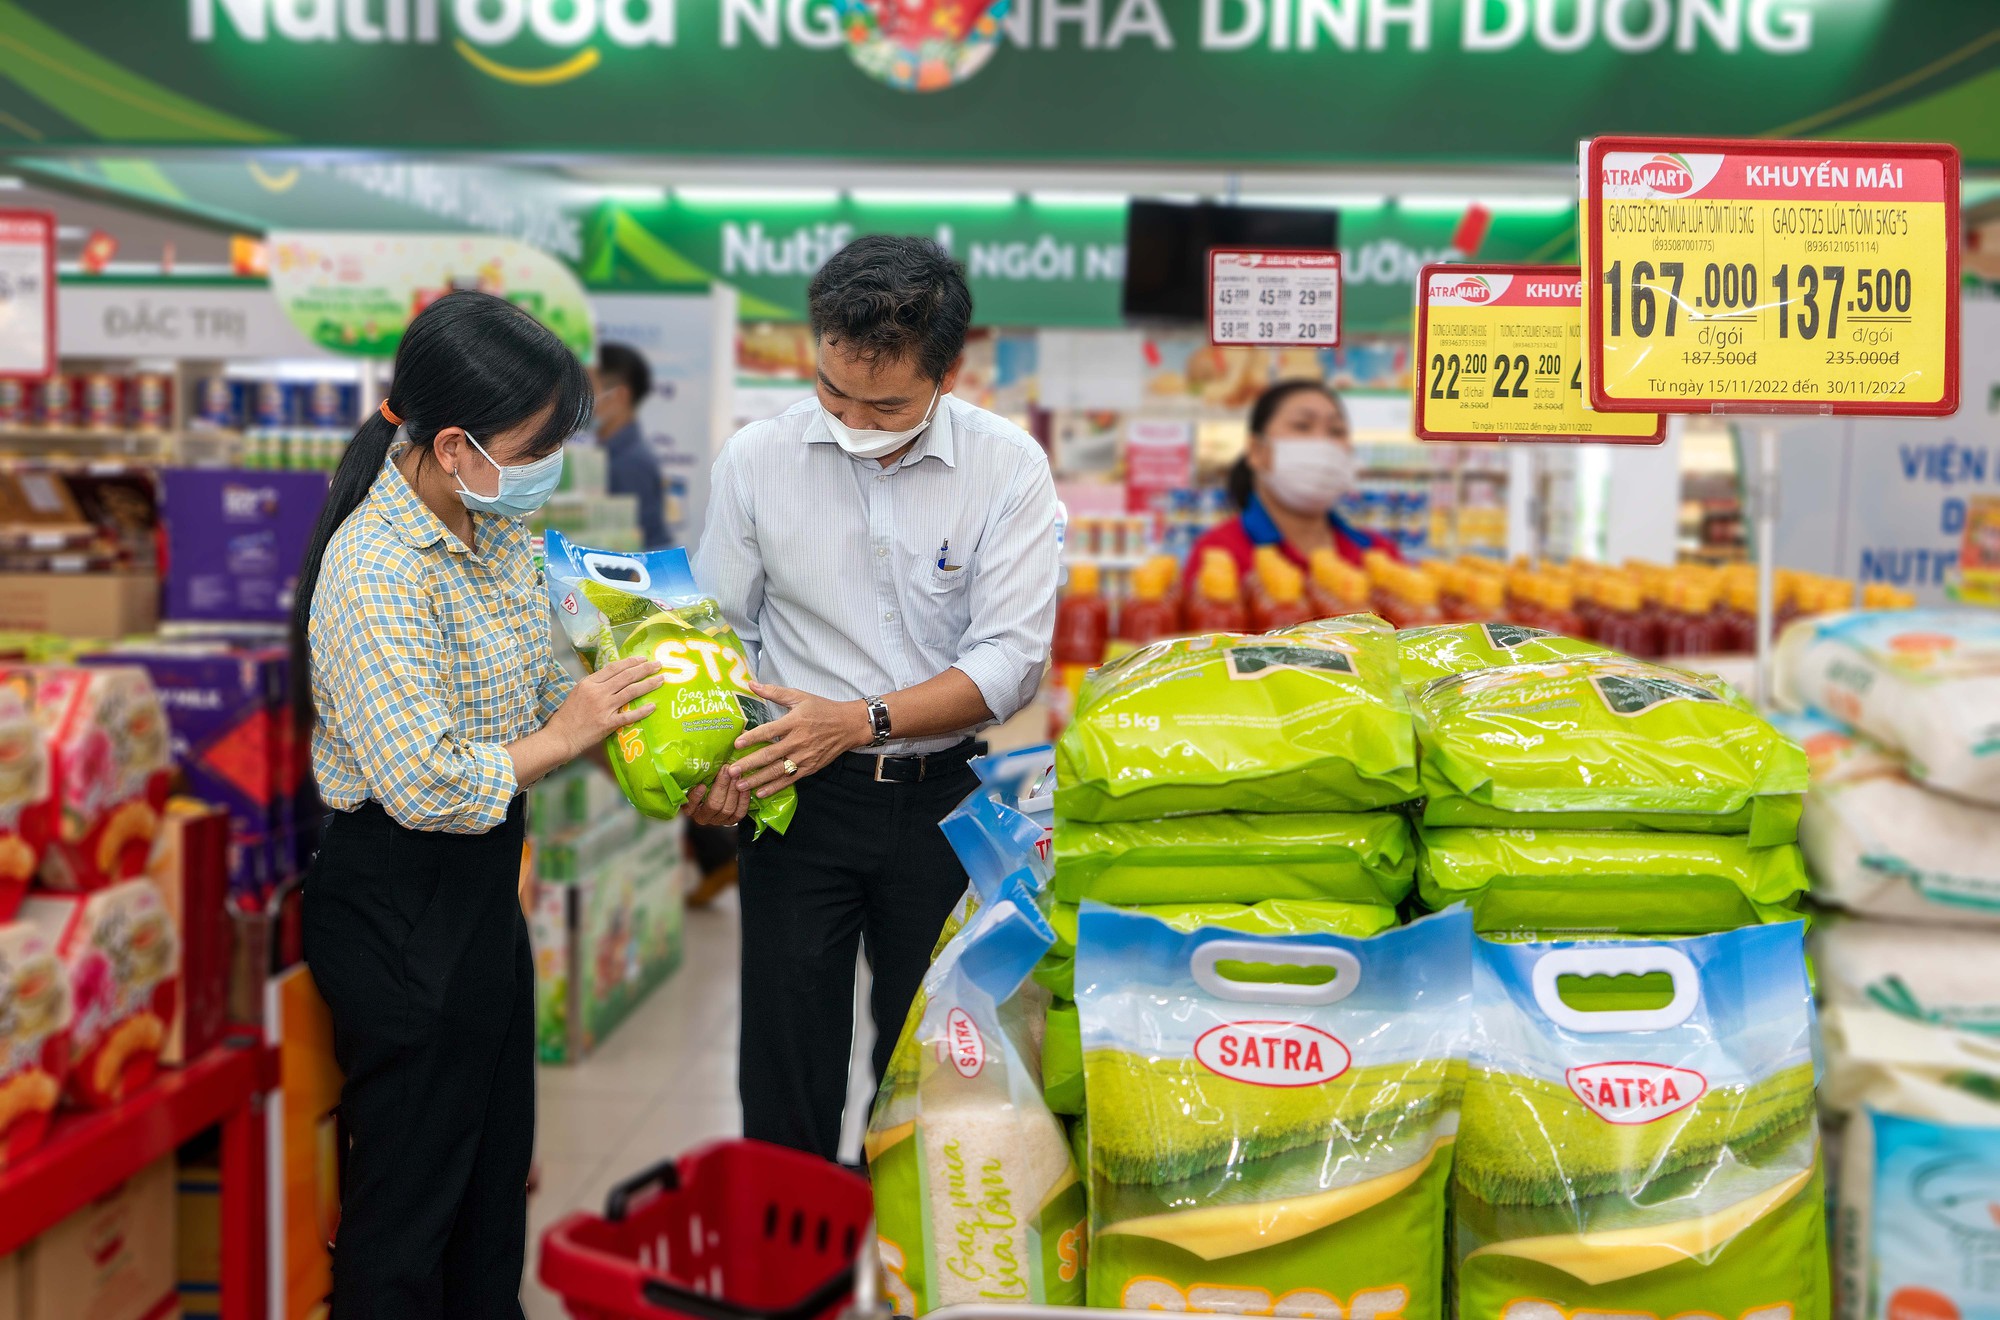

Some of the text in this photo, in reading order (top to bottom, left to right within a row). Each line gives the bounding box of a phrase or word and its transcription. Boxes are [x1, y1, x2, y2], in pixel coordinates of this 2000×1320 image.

[1745, 160, 1903, 188] KHUYẾN MÃI
[1629, 205, 1647, 233] ST25
[1739, 206, 1755, 234] 5KG
[1772, 207, 1797, 240] GẠO
[1799, 208, 1824, 235] ST25
[1827, 203, 1848, 235] LÚA
[1849, 203, 1873, 235] TÔM
[1652, 240, 1715, 252] (8935087001775)
[1804, 241, 1879, 254] (8936121051114)
[1526, 281, 1582, 298] KHUYÊ
[1698, 326, 1743, 349] đ/gói
[1852, 328, 1893, 346] đ/gói
[1682, 351, 1757, 365] 187.500đ
[1825, 351, 1900, 365] 235.000đ
[1648, 378, 1906, 396] Từ ngày 15/11/2022 đến 30/11/2022
[1496, 422, 1530, 431] 15/11/2022
[1559, 423, 1592, 432] 30/11/2022
[653, 637, 755, 692] ST2
[960, 1020, 977, 1068] SATRA
[1219, 1035, 1324, 1073] SATRA
[1577, 1076, 1682, 1108] SATRA
[946, 1223, 985, 1282] Gạo
